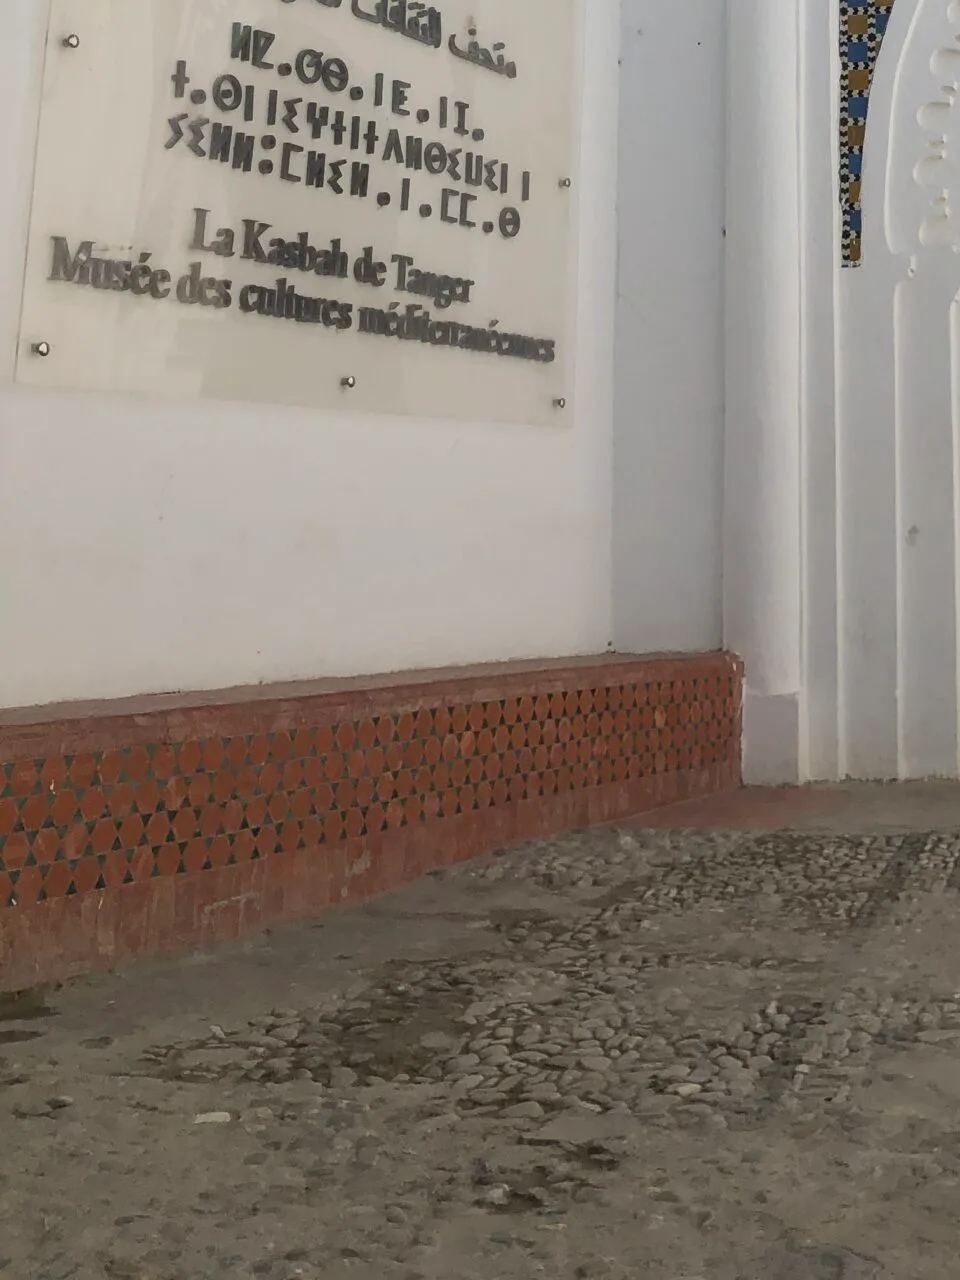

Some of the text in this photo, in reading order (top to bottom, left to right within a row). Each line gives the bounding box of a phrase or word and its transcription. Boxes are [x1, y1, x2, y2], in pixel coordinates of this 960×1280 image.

[447, 28, 517, 80] متحف
[46, 235, 556, 364] Musée des cultures méditerranéennes
[189, 207, 475, 309] La Kasbah de Tanger
